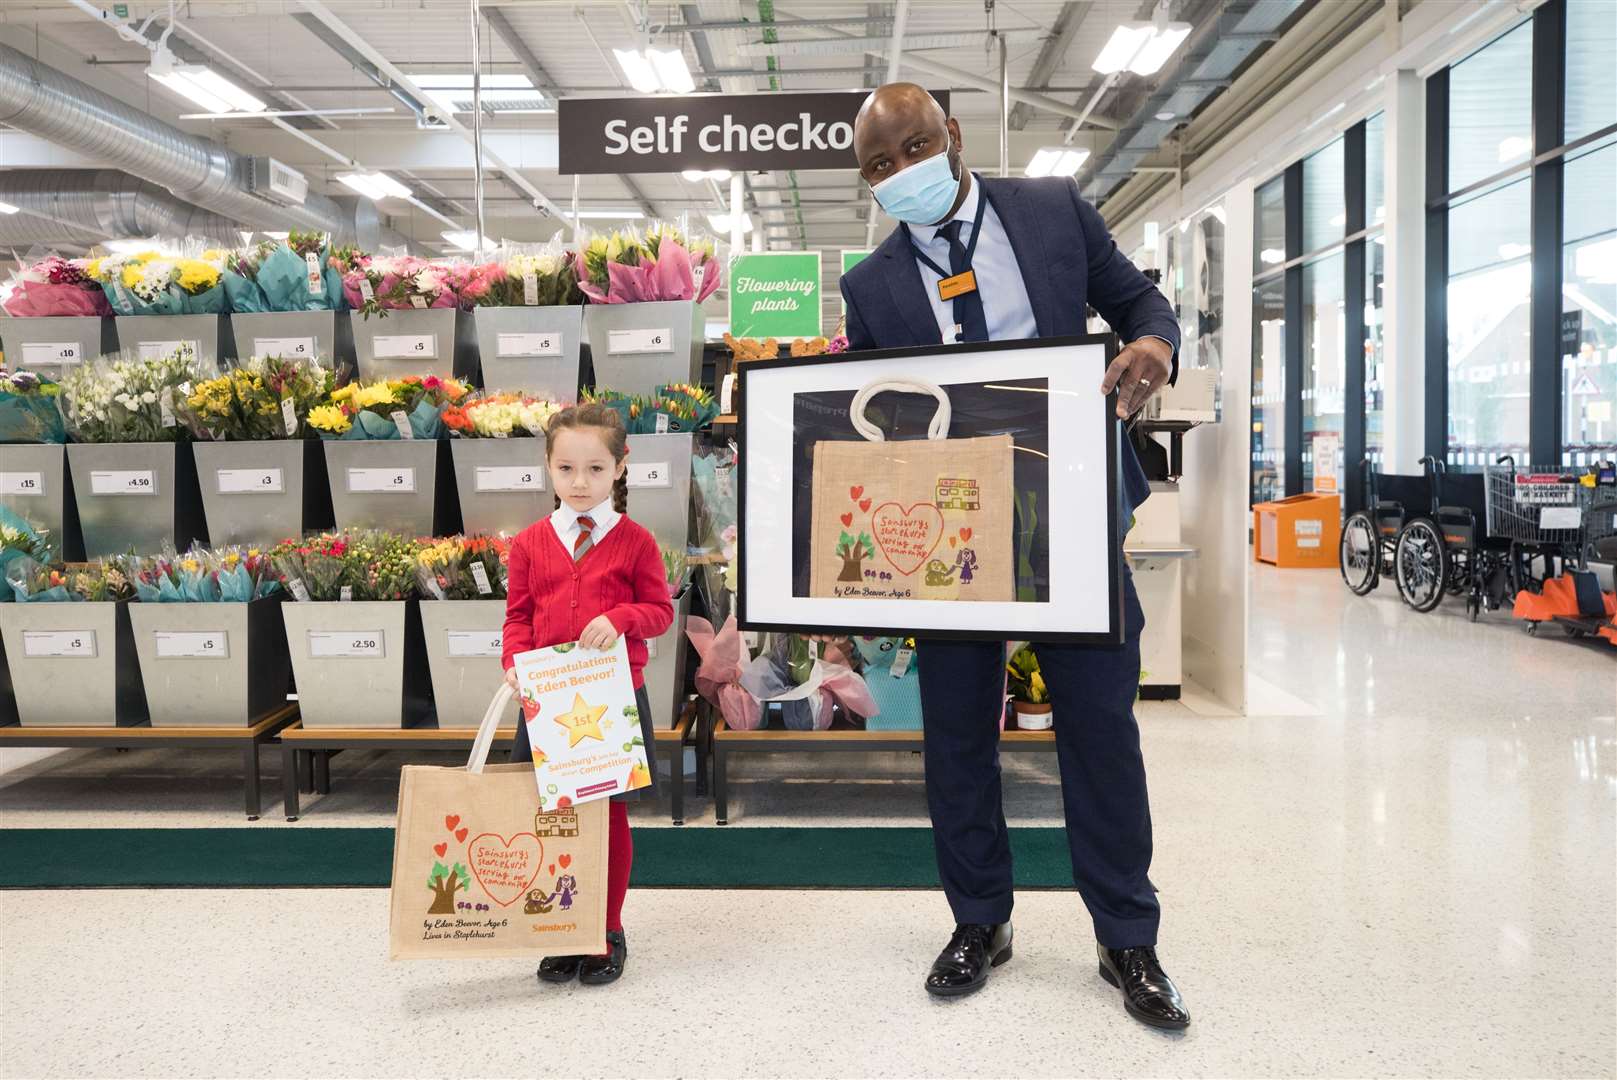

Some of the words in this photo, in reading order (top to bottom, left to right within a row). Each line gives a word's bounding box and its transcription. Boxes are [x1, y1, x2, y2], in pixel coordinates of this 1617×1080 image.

[604, 115, 689, 155] Self
[699, 112, 854, 153] checko
[736, 277, 816, 296] Flowering
[750, 297, 799, 314] plants
[540, 339, 550, 348] £5
[651, 336, 662, 345] £6
[295, 344, 305, 353] £5
[415, 342, 424, 351] £5
[60, 349, 74, 357] £10
[521, 474, 532, 482] £3
[648, 471, 658, 480] £5
[21, 480, 35, 488] £15
[262, 476, 272, 485] £3
[393, 476, 403, 485] £5
[843, 586, 861, 596] Eden
[888, 588, 905, 599] Age
[905, 589, 911, 597] 6
[71, 639, 82, 648] £5
[203, 640, 214, 649] £5
[352, 640, 375, 648] £2.50
[491, 639, 503, 647] £2.
[528, 655, 617, 681] Congratulations
[536, 678, 567, 694] Eden
[569, 667, 616, 686] Beevor!
[573, 713, 592, 727] 1st
[548, 754, 597, 774] Sainsbury's
[579, 757, 632, 775] Competition
[423, 919, 432, 930] by
[434, 918, 453, 928] Eden
[483, 918, 501, 930] Age
[501, 918, 508, 927] 6
[423, 930, 442, 940] Lives
[443, 931, 452, 939] in
[453, 929, 496, 941] Staplehurst
